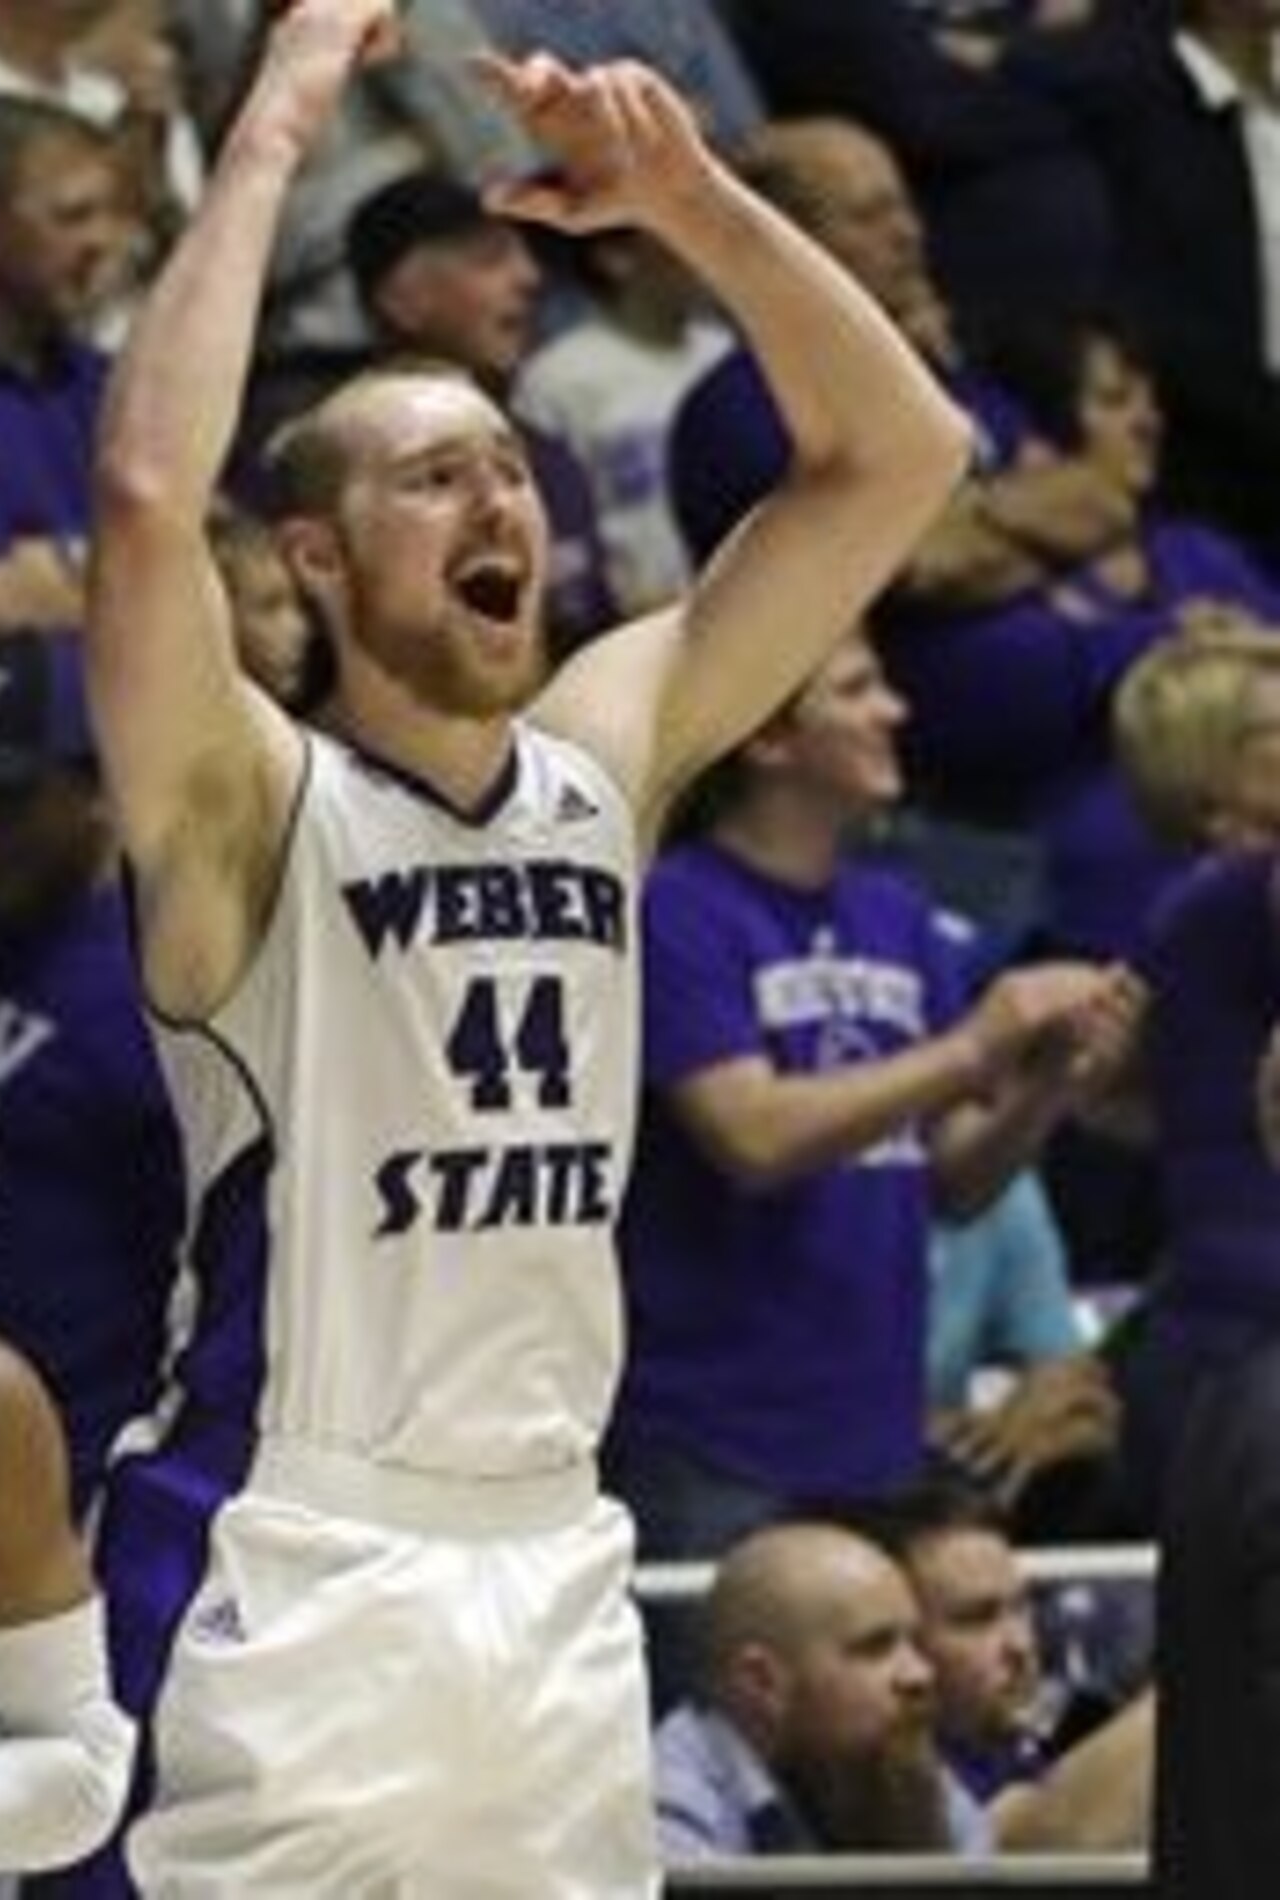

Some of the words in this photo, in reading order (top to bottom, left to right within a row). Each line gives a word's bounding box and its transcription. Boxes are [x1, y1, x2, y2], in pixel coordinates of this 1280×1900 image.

[340, 858, 627, 963] WEBER
[444, 974, 573, 1113] 44
[371, 1142, 613, 1241] STATE
